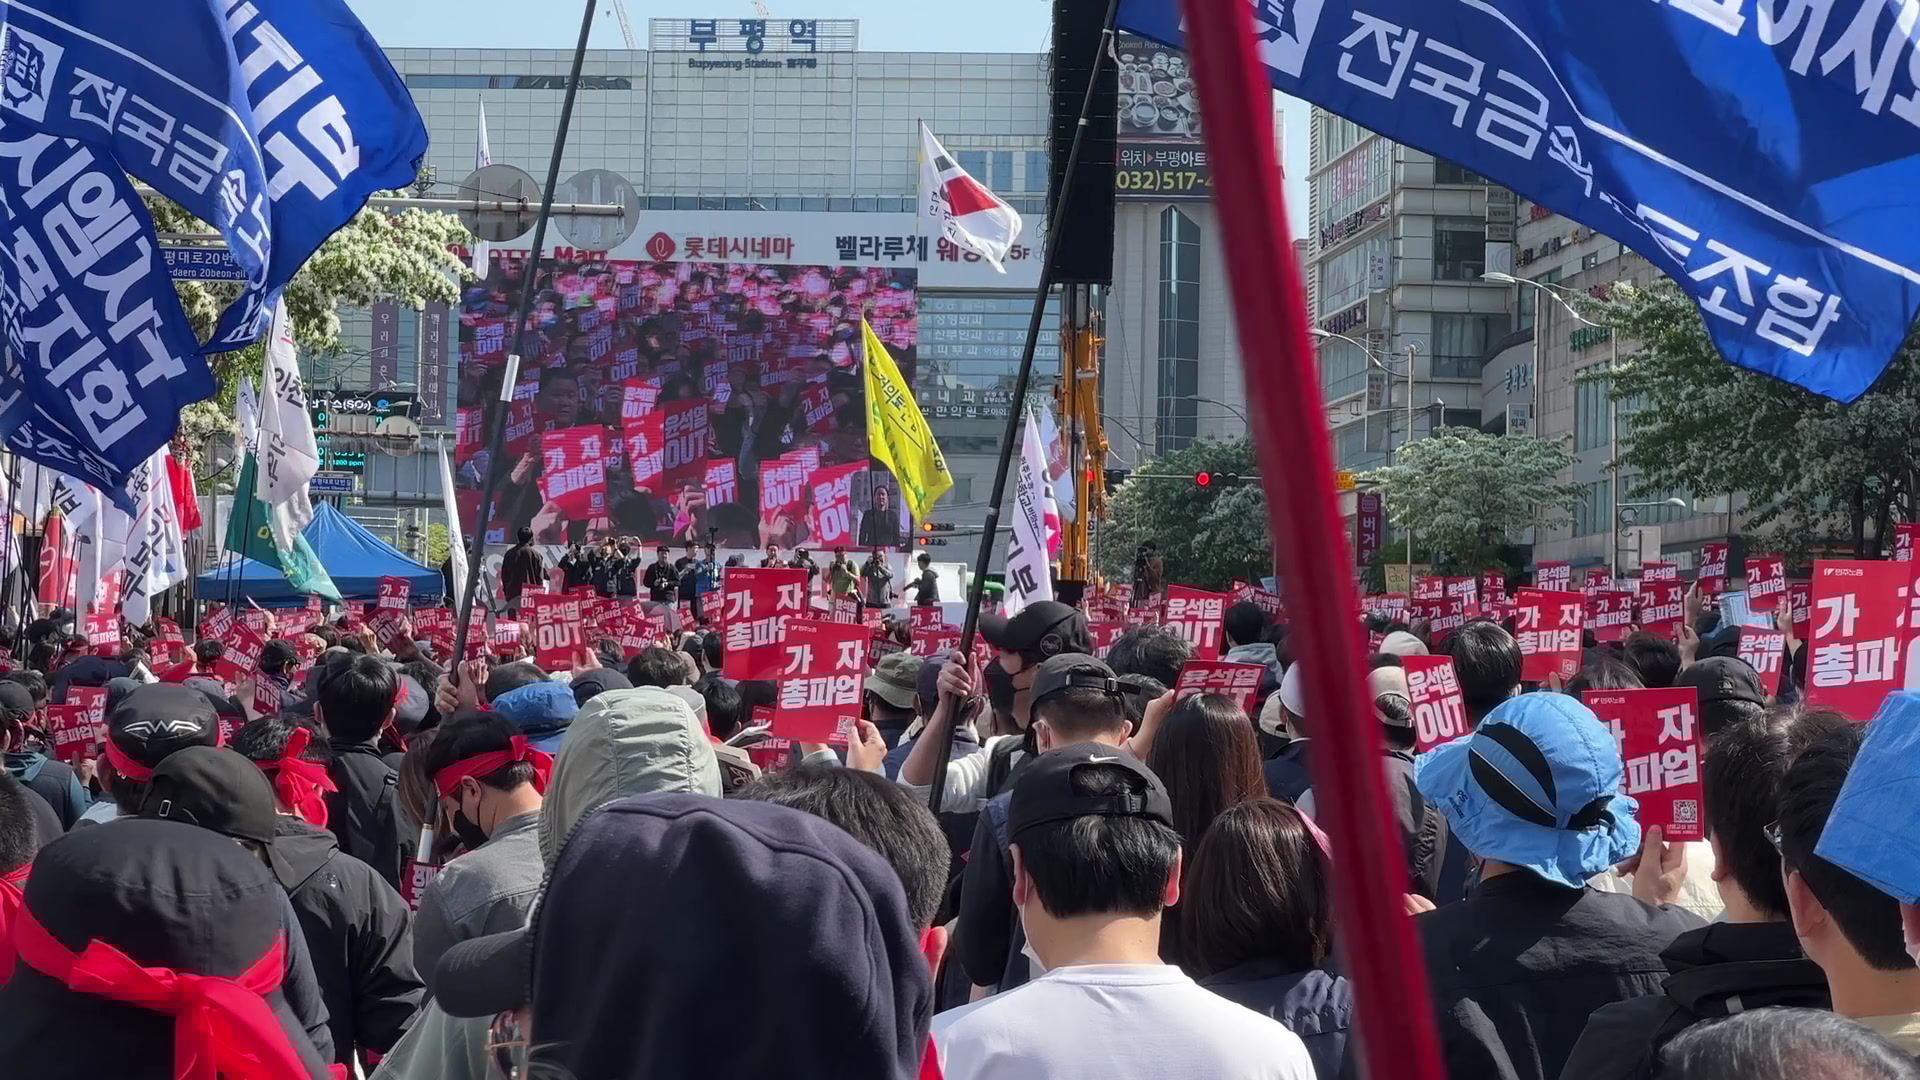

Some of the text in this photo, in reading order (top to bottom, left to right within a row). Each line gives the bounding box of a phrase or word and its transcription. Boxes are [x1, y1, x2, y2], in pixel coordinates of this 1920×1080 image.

[689, 19, 817, 54] 부평역
[688, 58, 782, 71] Bupyeong Station
[1121, 150, 1147, 167] 위치
[684, 235, 794, 260] 롯데시네마
[835, 235, 928, 262] 벨라루체
[1010, 244, 1031, 261] 5F
[477, 336, 503, 355] OUT
[622, 400, 655, 418] OUT
[802, 387, 830, 414] 가 자
[665, 404, 708, 440] 윤석열
[545, 435, 601, 471] 가 자
[628, 433, 648, 457] 가
[665, 430, 708, 470] OUT
[548, 458, 604, 499] 총파업
[763, 464, 800, 485] 윤석열
[764, 483, 800, 510] OUT
[814, 472, 850, 511] 윤석
[1537, 566, 1570, 582] 윤석열
[1643, 566, 1677, 582] 윤석열
[1747, 562, 1784, 582] 가 자
[382, 584, 409, 597] 가 자
[1641, 587, 1683, 607] 가 자
[1749, 577, 1786, 598] 총파업
[726, 582, 804, 620] 가 자
[1168, 599, 1223, 619] 윤석열
[1429, 602, 1463, 619] 가 자
[1597, 597, 1632, 613] 가 자
[1792, 592, 1808, 607] 가
[537, 600, 580, 624] 윤석열
[911, 611, 942, 627] 가 자
[1431, 613, 1464, 632] 총파업
[1517, 603, 1582, 629] 가 자
[1596, 610, 1632, 627] 총파업
[1641, 602, 1684, 624] 총파업
[1815, 593, 1860, 639] 가
[88, 618, 118, 633] 가 자
[539, 621, 582, 651] OUT
[625, 624, 655, 638] 가 자
[230, 633, 260, 658] 가 자
[496, 631, 519, 645] OUT
[622, 635, 652, 648] 총파업
[1516, 628, 1581, 656] 총파업
[1740, 634, 1785, 651] 윤석열
[784, 643, 813, 675] 가
[835, 639, 864, 671] 자
[1812, 637, 1899, 687] 총파
[1182, 668, 1262, 686] 윤석열
[1407, 662, 1458, 704] 윤석열
[256, 685, 280, 712] OUT
[780, 673, 861, 709] 총파업
[51, 711, 91, 729] 가 자
[1415, 695, 1464, 744] OUT
[1657, 703, 1695, 745] 자
[55, 727, 93, 745] 총파업
[1620, 744, 1698, 794] 파업
